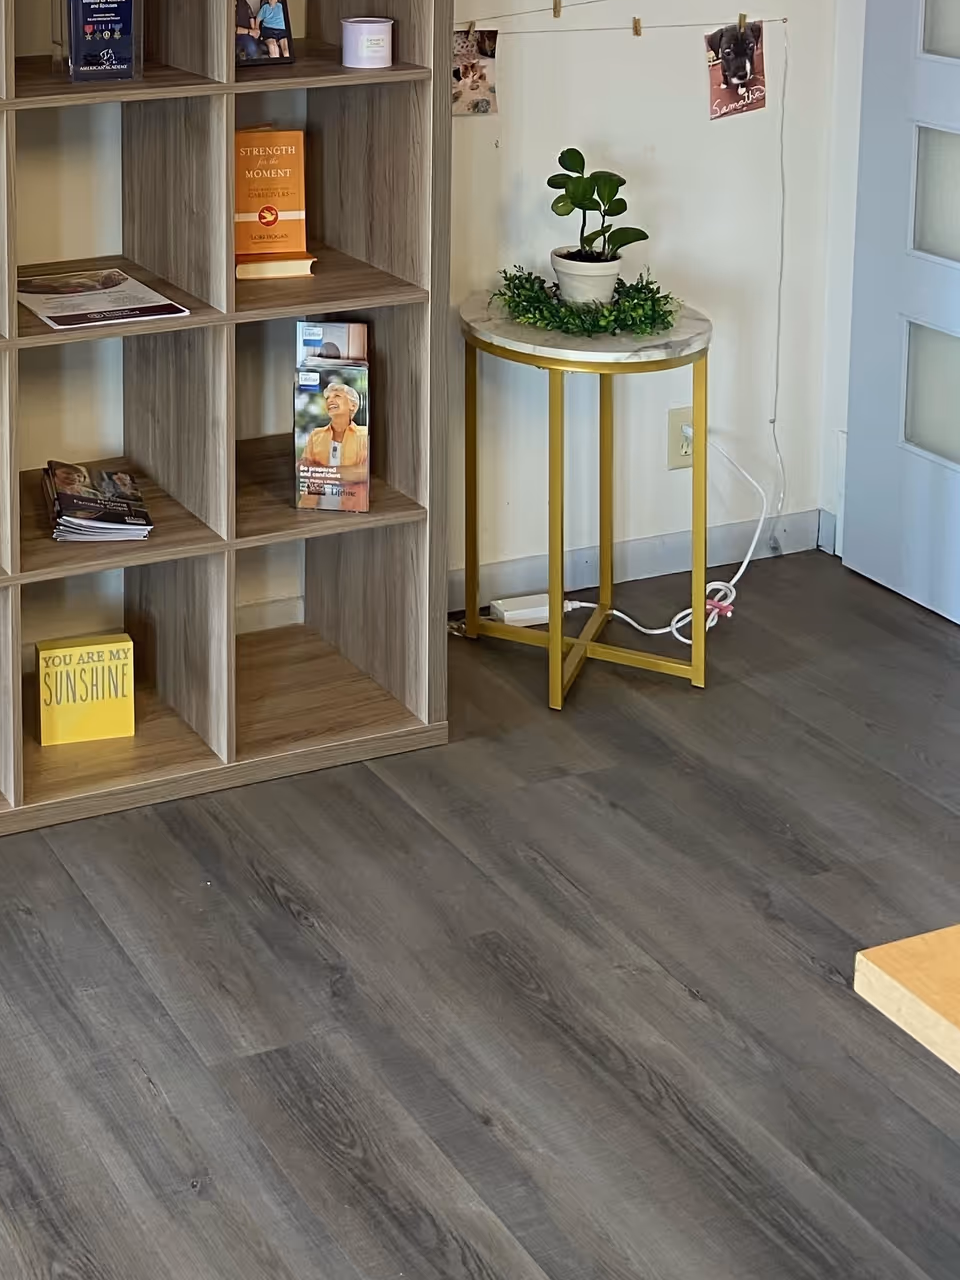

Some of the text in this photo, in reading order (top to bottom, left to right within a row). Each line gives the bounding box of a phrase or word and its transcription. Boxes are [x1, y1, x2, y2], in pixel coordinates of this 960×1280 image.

[240, 145, 296, 157] STRENGTH
[245, 169, 292, 179] MOMENT
[42, 648, 131, 669] YOU ARE MY
[43, 663, 129, 707] SUNSHINE
